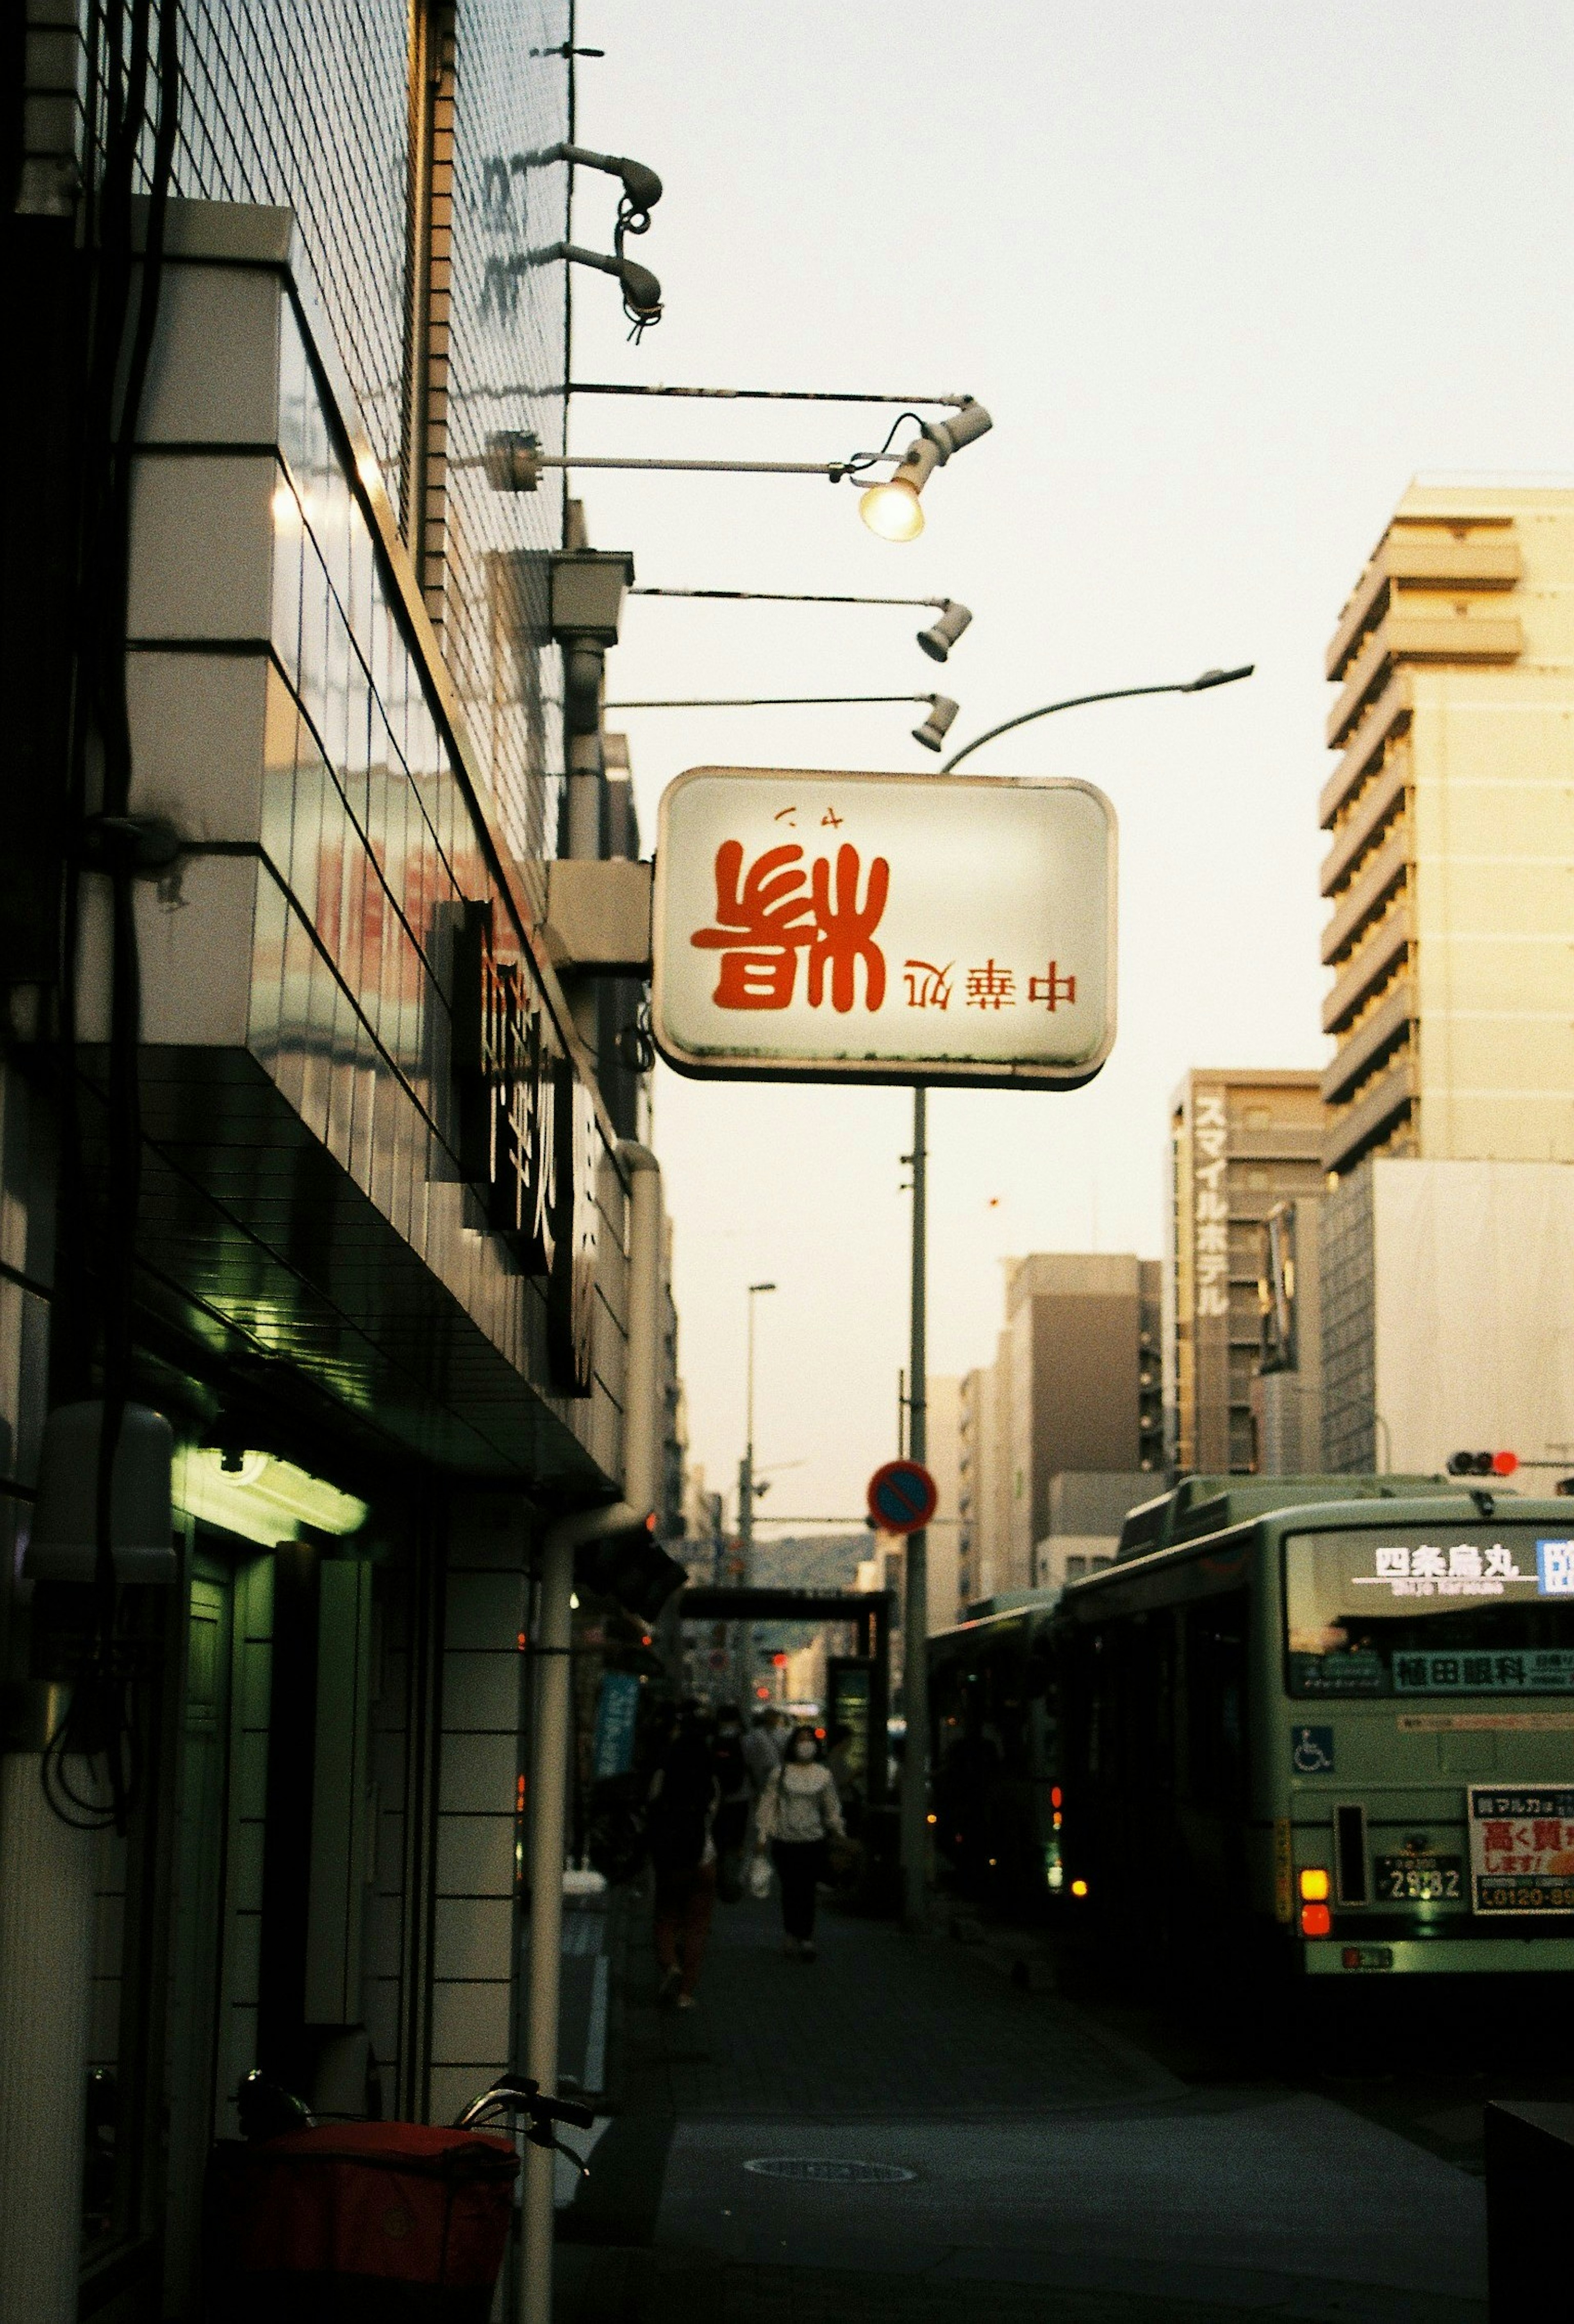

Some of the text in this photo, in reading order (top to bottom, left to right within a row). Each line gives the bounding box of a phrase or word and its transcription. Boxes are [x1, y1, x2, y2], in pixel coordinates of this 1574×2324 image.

[774, 806, 843, 829] ヤン
[690, 840, 890, 1013] 楊
[904, 958, 1076, 1011] 中華処
[1195, 1096, 1229, 1316] スマイルホテル
